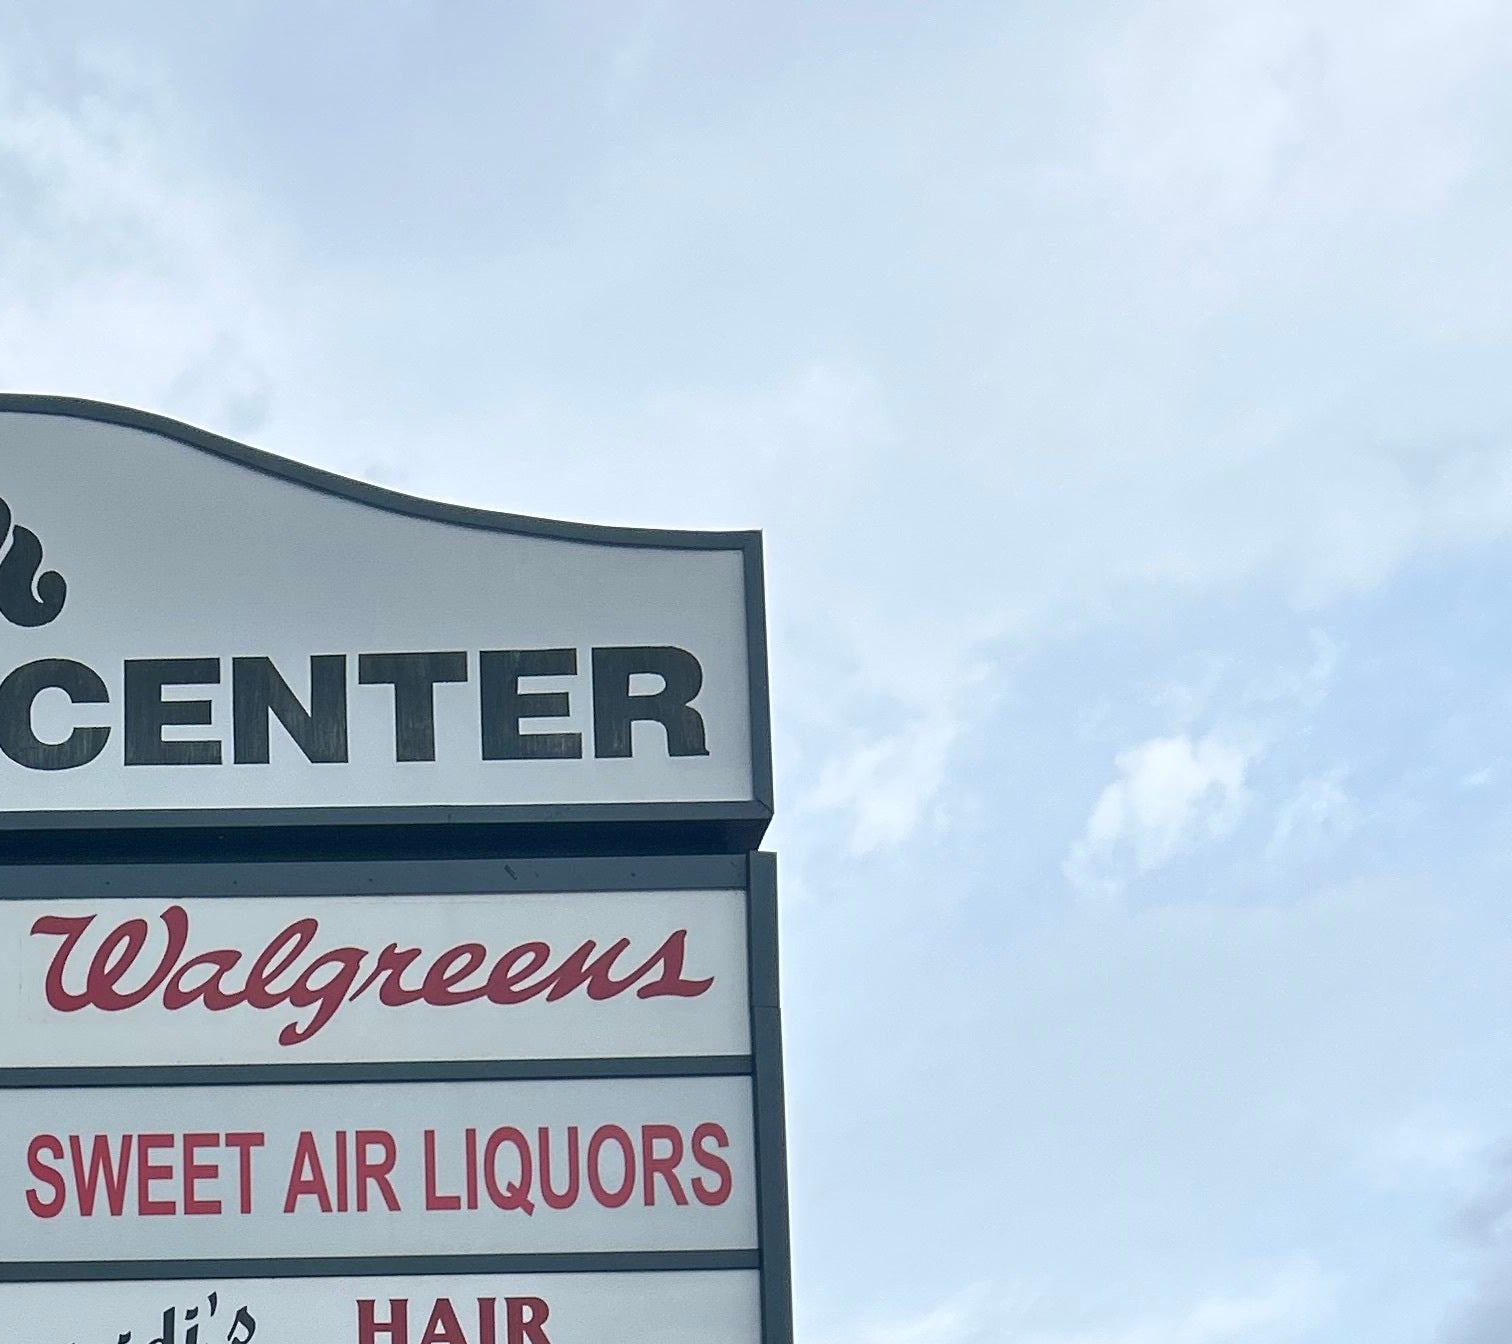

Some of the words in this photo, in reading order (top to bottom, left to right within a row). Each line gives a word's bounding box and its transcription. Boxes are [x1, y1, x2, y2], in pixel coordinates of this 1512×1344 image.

[30, 906, 714, 1046] Walgreens
[26, 1132, 264, 1218] SWEET
[284, 1130, 401, 1213] AIR
[424, 1123, 732, 1216] LIQUORS
